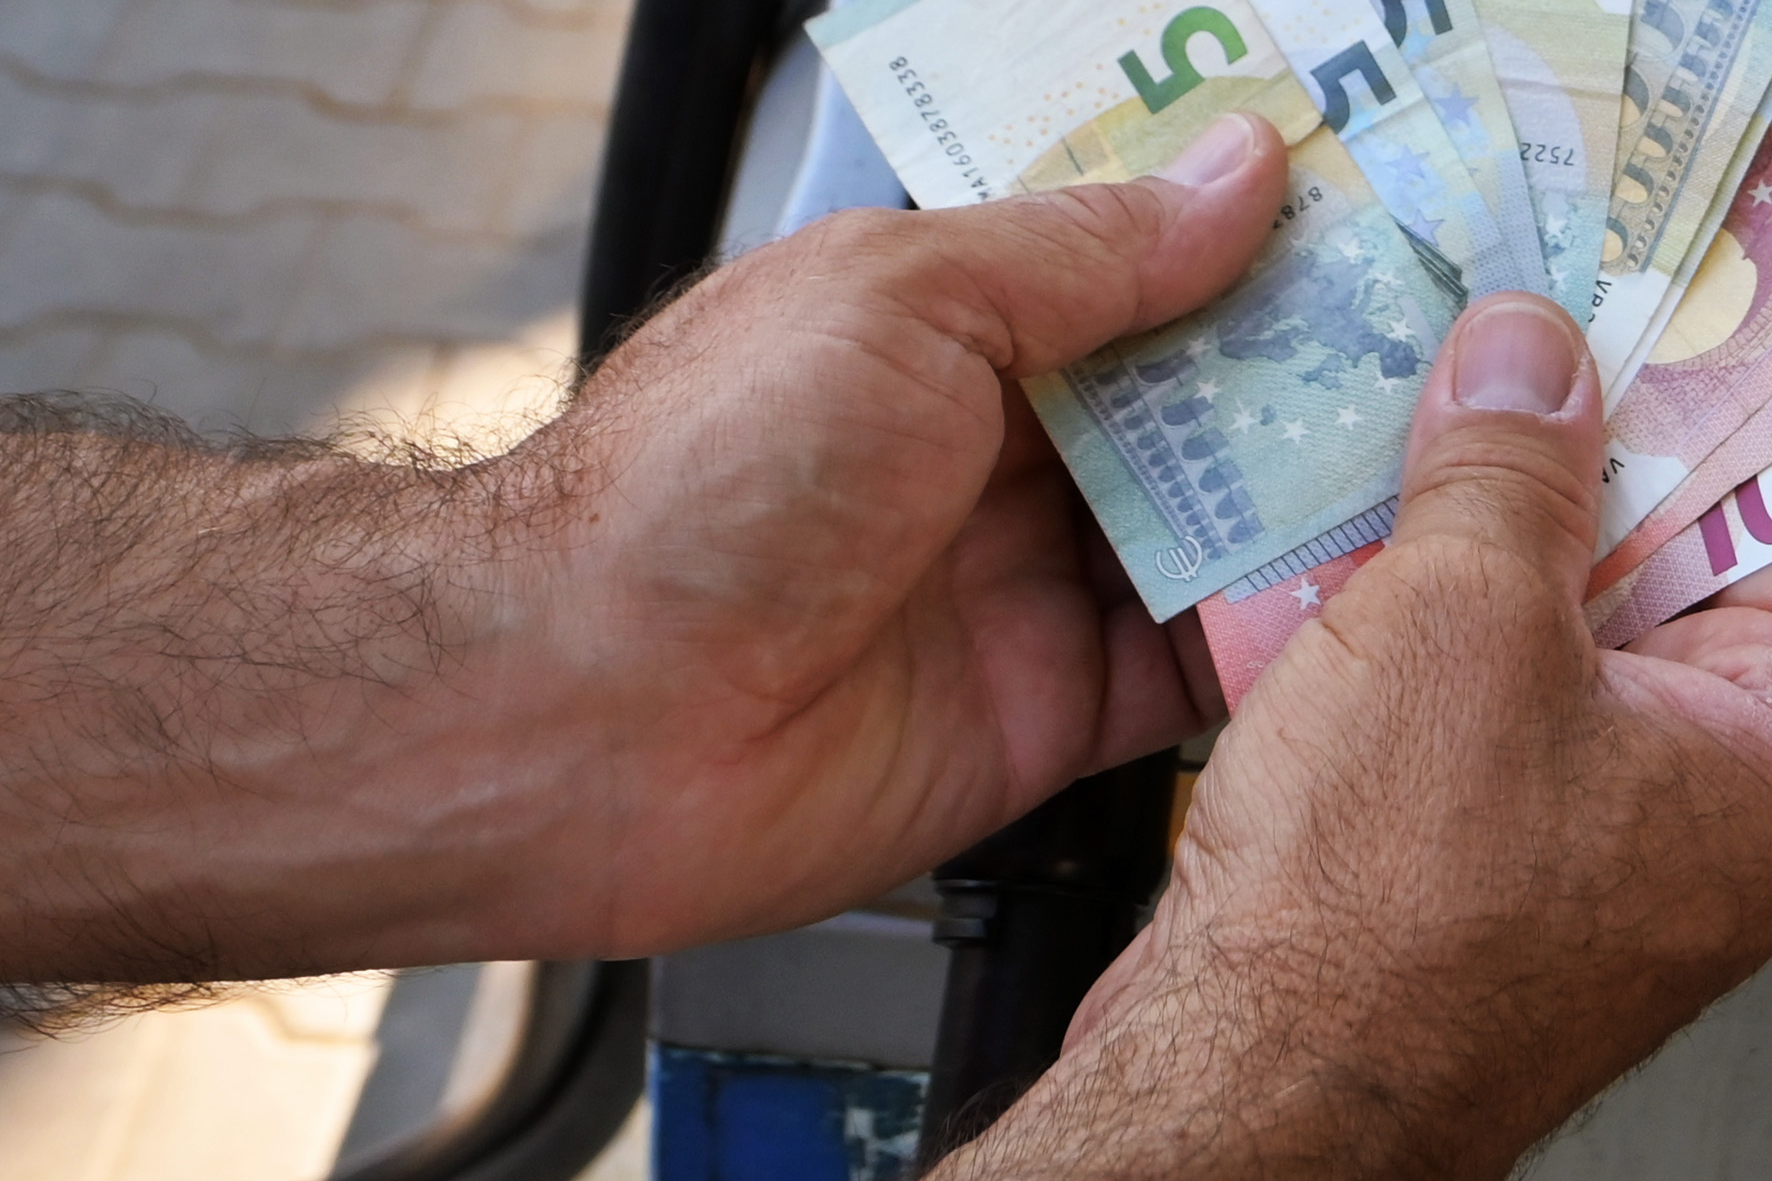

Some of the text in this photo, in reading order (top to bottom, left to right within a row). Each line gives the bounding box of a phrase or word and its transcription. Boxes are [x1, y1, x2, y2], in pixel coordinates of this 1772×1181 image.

[1117, 6, 1248, 115] 5
[1309, 39, 1397, 135] 5
[1519, 142, 1574, 166] 7522
[1588, 279, 1612, 323] VP
